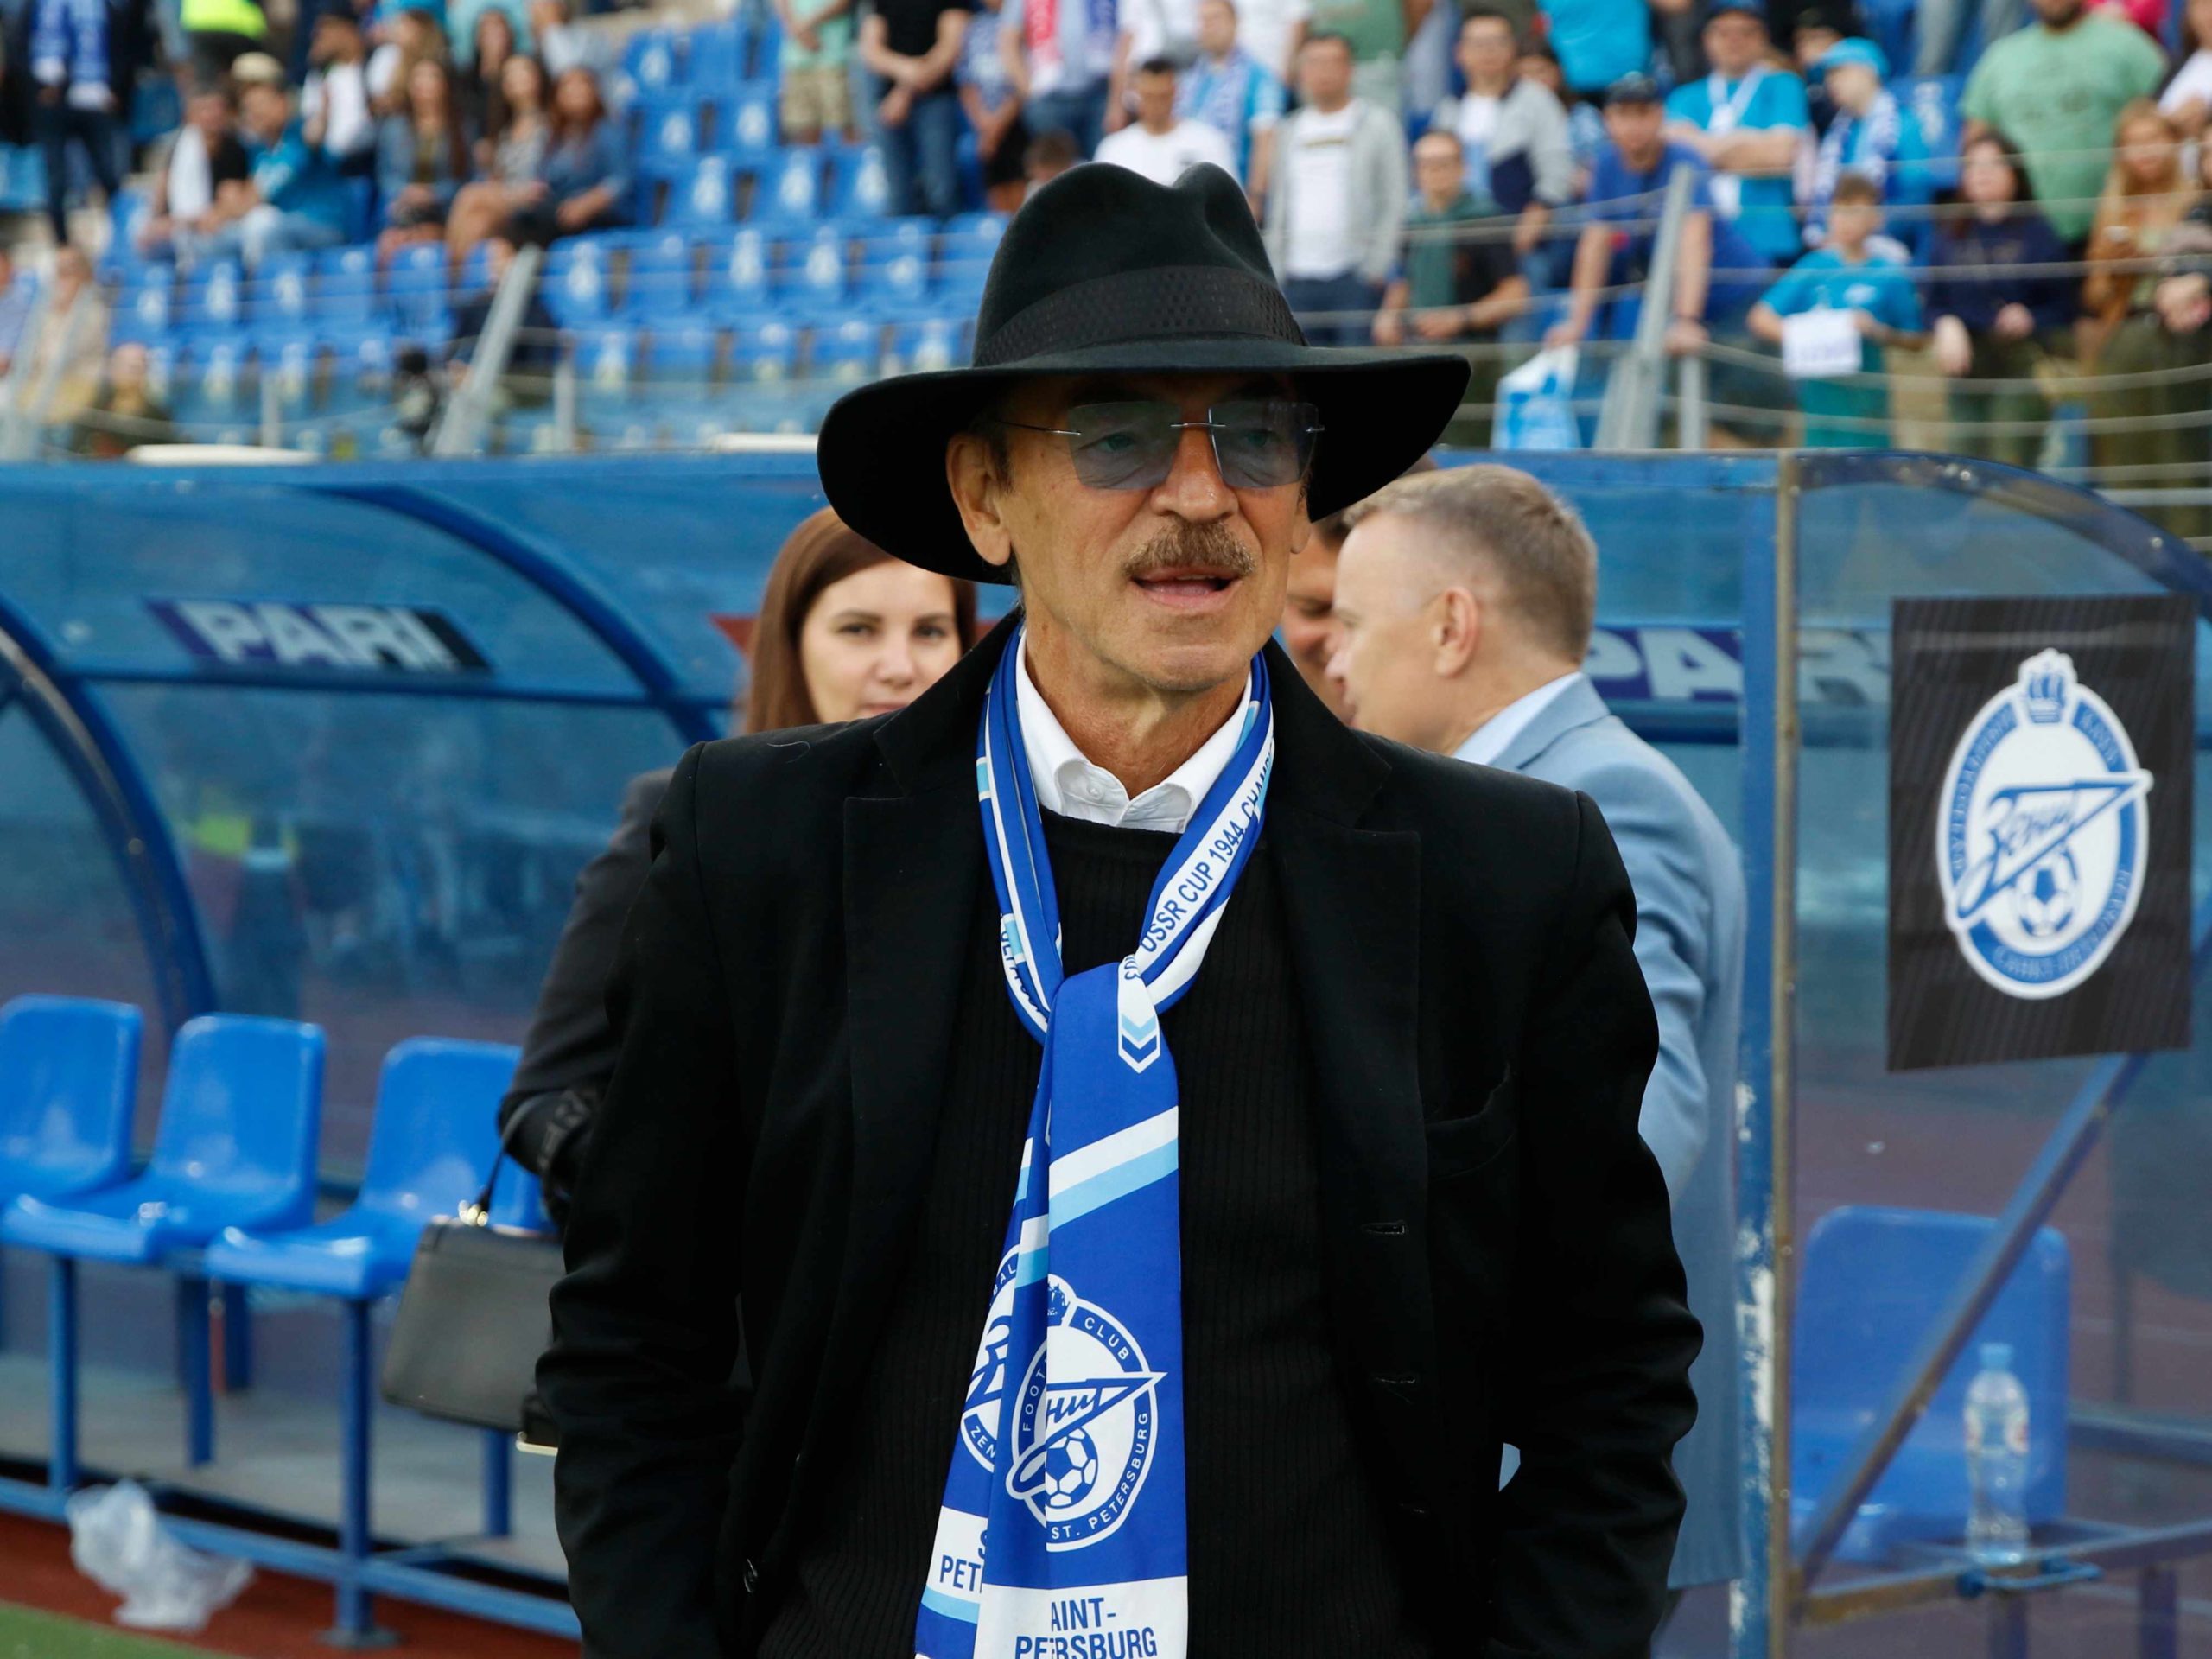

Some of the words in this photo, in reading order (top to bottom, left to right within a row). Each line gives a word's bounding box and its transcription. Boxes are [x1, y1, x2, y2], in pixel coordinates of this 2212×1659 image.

[177, 601, 461, 671] PARI
[1139, 899, 1188, 953] USSR
[1178, 861, 1214, 904] CUP
[1084, 1316, 1130, 1361] CLUB
[1051, 1524, 1080, 1540] ST.
[1087, 1412, 1148, 1531] PETERSBURG
[938, 1555, 982, 1594] PET
